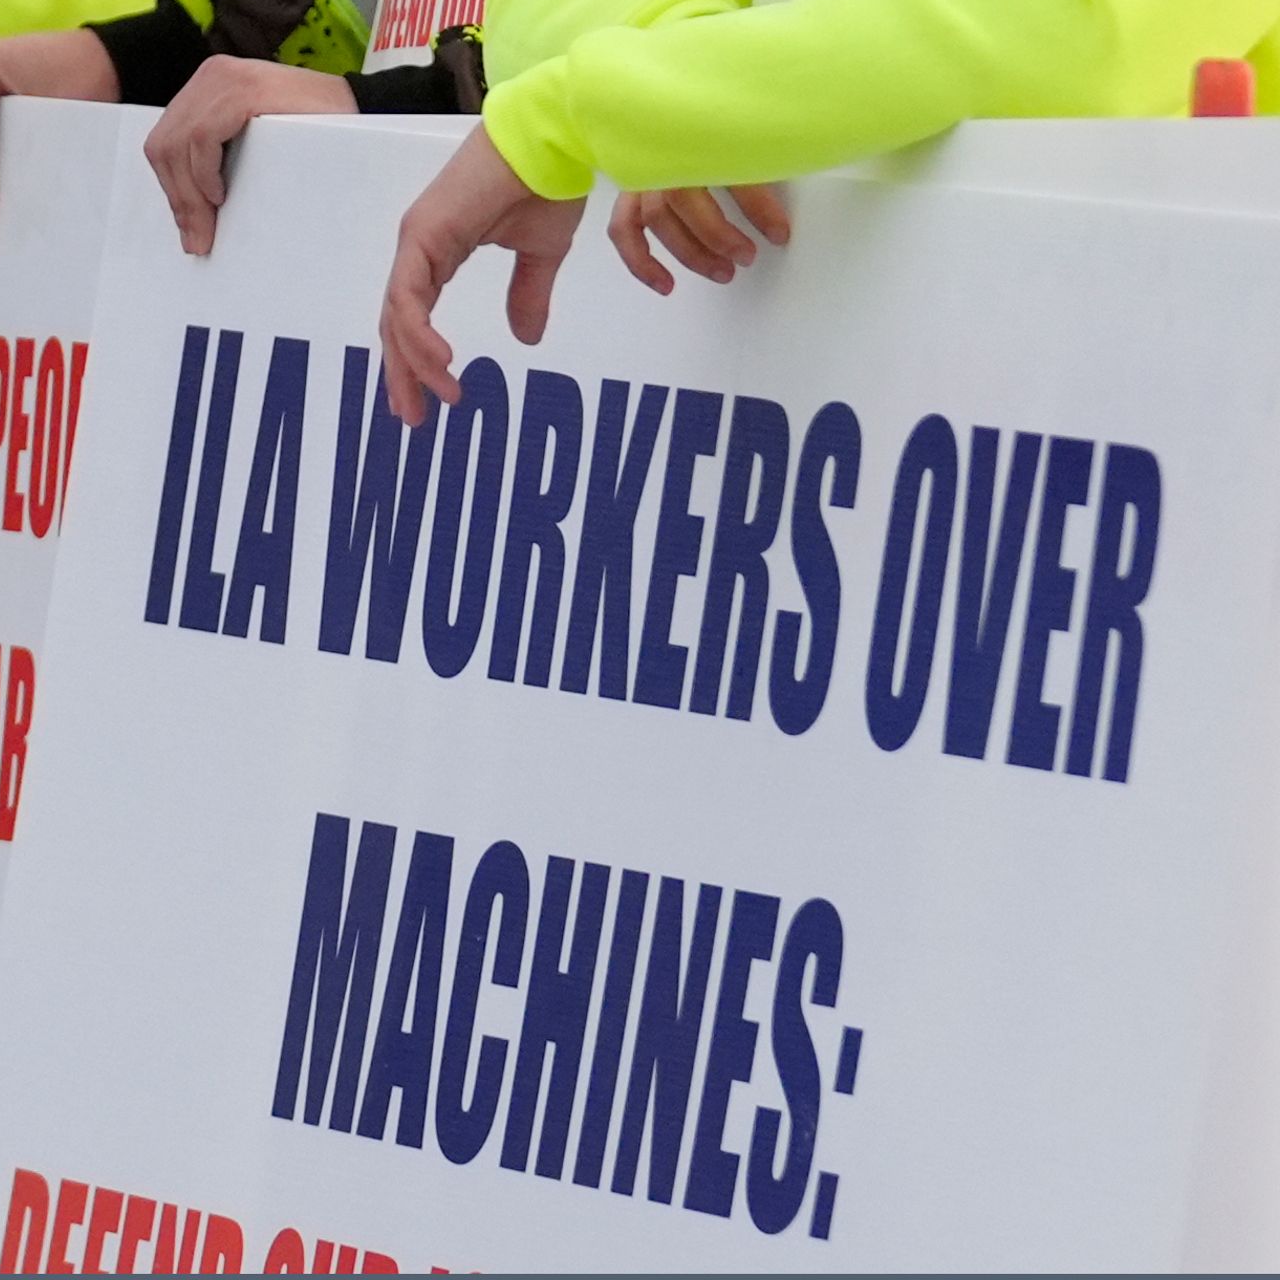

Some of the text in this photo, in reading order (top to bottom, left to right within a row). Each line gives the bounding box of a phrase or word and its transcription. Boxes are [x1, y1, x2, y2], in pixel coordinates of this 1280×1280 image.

[143, 324, 1163, 784] ILA WORKERS OVER
[271, 812, 864, 1241] MACHINES:
